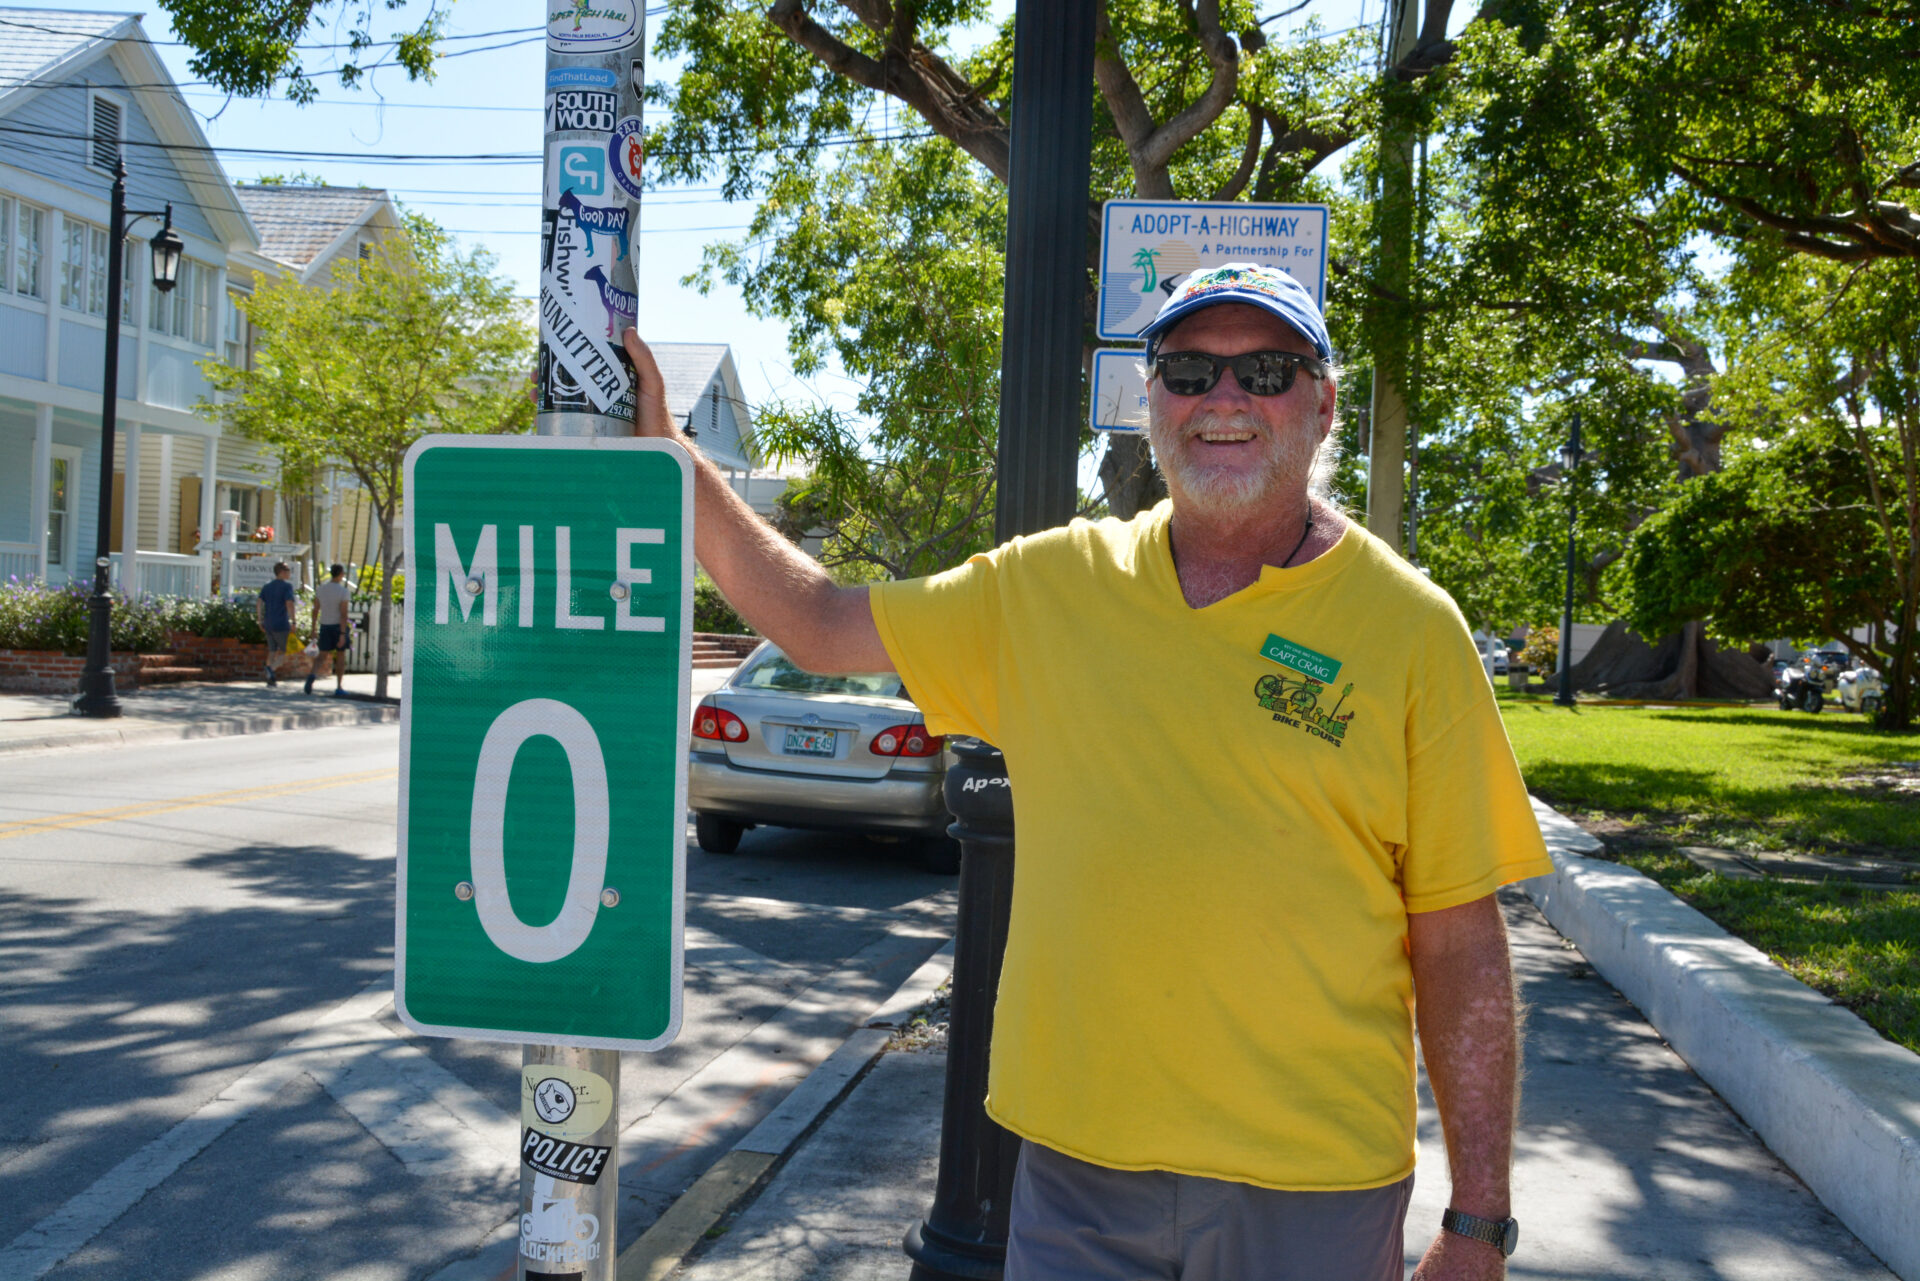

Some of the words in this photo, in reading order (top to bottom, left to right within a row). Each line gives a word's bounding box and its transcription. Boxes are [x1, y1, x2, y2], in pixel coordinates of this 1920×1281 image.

[557, 92, 615, 112] SOUTH
[557, 110, 614, 131] WOOD
[617, 121, 637, 138] FAT
[579, 205, 604, 227] GOOD
[607, 211, 626, 230] DAY
[1131, 214, 1300, 238] ADOPT-A-HIGHWAY
[1201, 244, 1210, 254] A
[1216, 244, 1289, 258] Partnership
[1294, 245, 1314, 257] For
[604, 281, 626, 311] GOOD
[540, 285, 621, 400] #UNLITTER
[434, 522, 665, 633] MILE
[1269, 647, 1297, 665] CAPT.
[1297, 658, 1330, 678] CRAIG
[1258, 694, 1299, 716] KEY
[1272, 712, 1301, 729] BIKE
[1304, 724, 1342, 748] TOURS
[469, 697, 610, 964] 0
[523, 1131, 608, 1176] POLICE
[519, 1236, 601, 1263] BLOCKHEAD!
